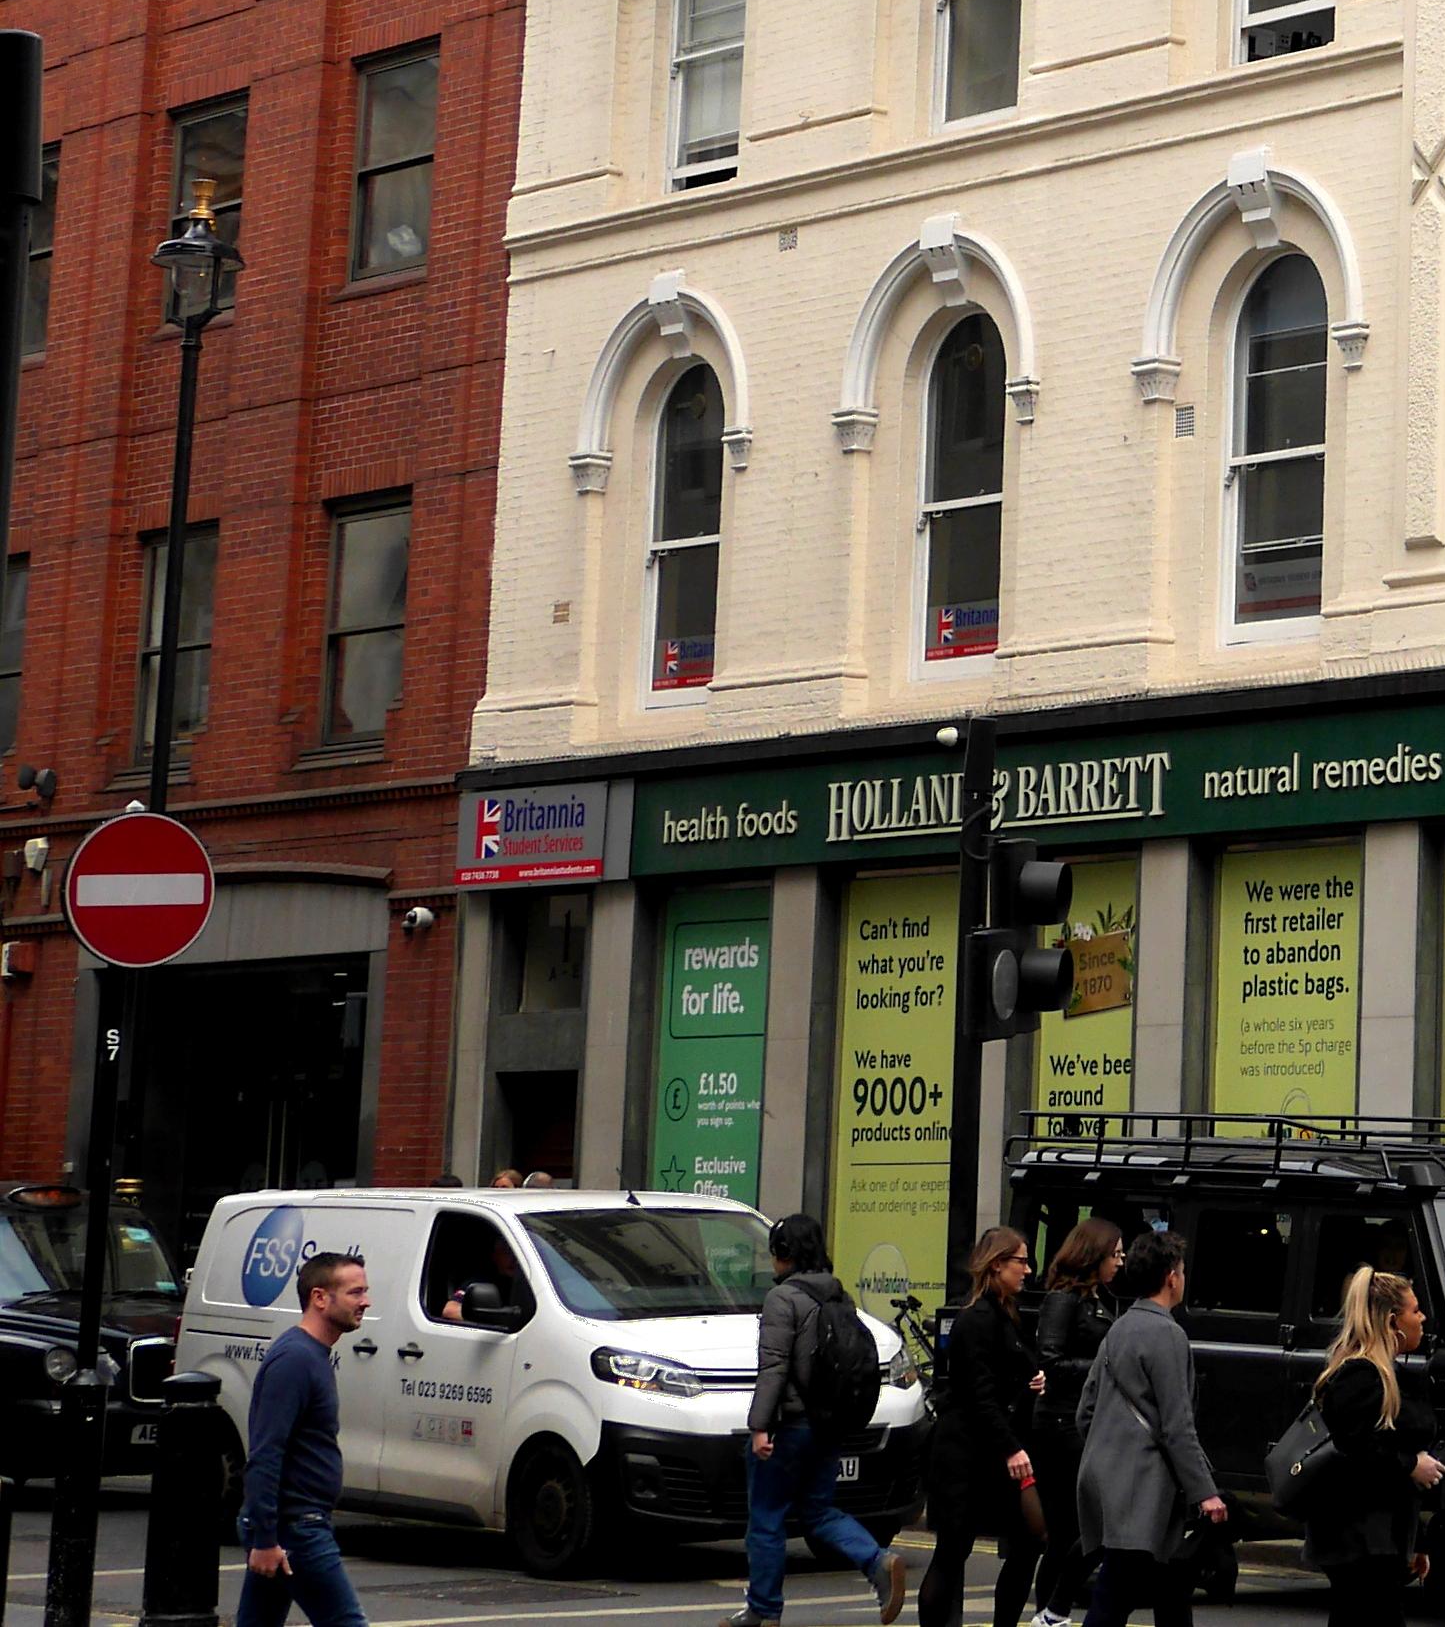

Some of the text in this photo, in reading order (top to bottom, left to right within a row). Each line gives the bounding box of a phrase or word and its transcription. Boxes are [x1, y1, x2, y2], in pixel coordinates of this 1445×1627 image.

[1203, 743, 1443, 800] natural remedies
[1016, 752, 1171, 818] BARRETT
[504, 795, 584, 833] Britannia
[663, 800, 798, 844] health foods
[502, 833, 584, 856] Student Services
[1245, 876, 1354, 902] We were the
[860, 916, 930, 940] Can't find
[1243, 908, 1344, 934] first retailer
[684, 937, 759, 971] rewards
[858, 950, 944, 978] what you're
[1079, 950, 1115, 971] Since
[1243, 939, 1341, 965] to abandon
[1083, 975, 1112, 996] 1870
[1242, 973, 1349, 1003] plastic bags.
[682, 982, 744, 1016] for life.
[857, 984, 944, 1013] looking for?
[1240, 1017, 1334, 1035] (a whole six years
[855, 1050, 911, 1068] We have
[1240, 1038, 1352, 1057] before the 5p charge
[1050, 1054, 1098, 1076] We've
[1240, 1061, 1325, 1077] was introduced)
[698, 1072, 737, 1095] £1.50
[697, 1100, 745, 1113] worth of points
[853, 1076, 943, 1116] 9000+
[1049, 1084, 1104, 1108] around
[697, 1116, 709, 1128] you
[710, 1116, 723, 1129] sign
[851, 1122, 911, 1147] products
[694, 1156, 746, 1174] Exclusive
[693, 1179, 728, 1198] Offers
[850, 1178, 917, 1192] Ask one of our
[850, 1200, 918, 1216] about ordering
[245, 1237, 295, 1277] FSS
[401, 1378, 492, 1404] Tel 023 9269 6596
